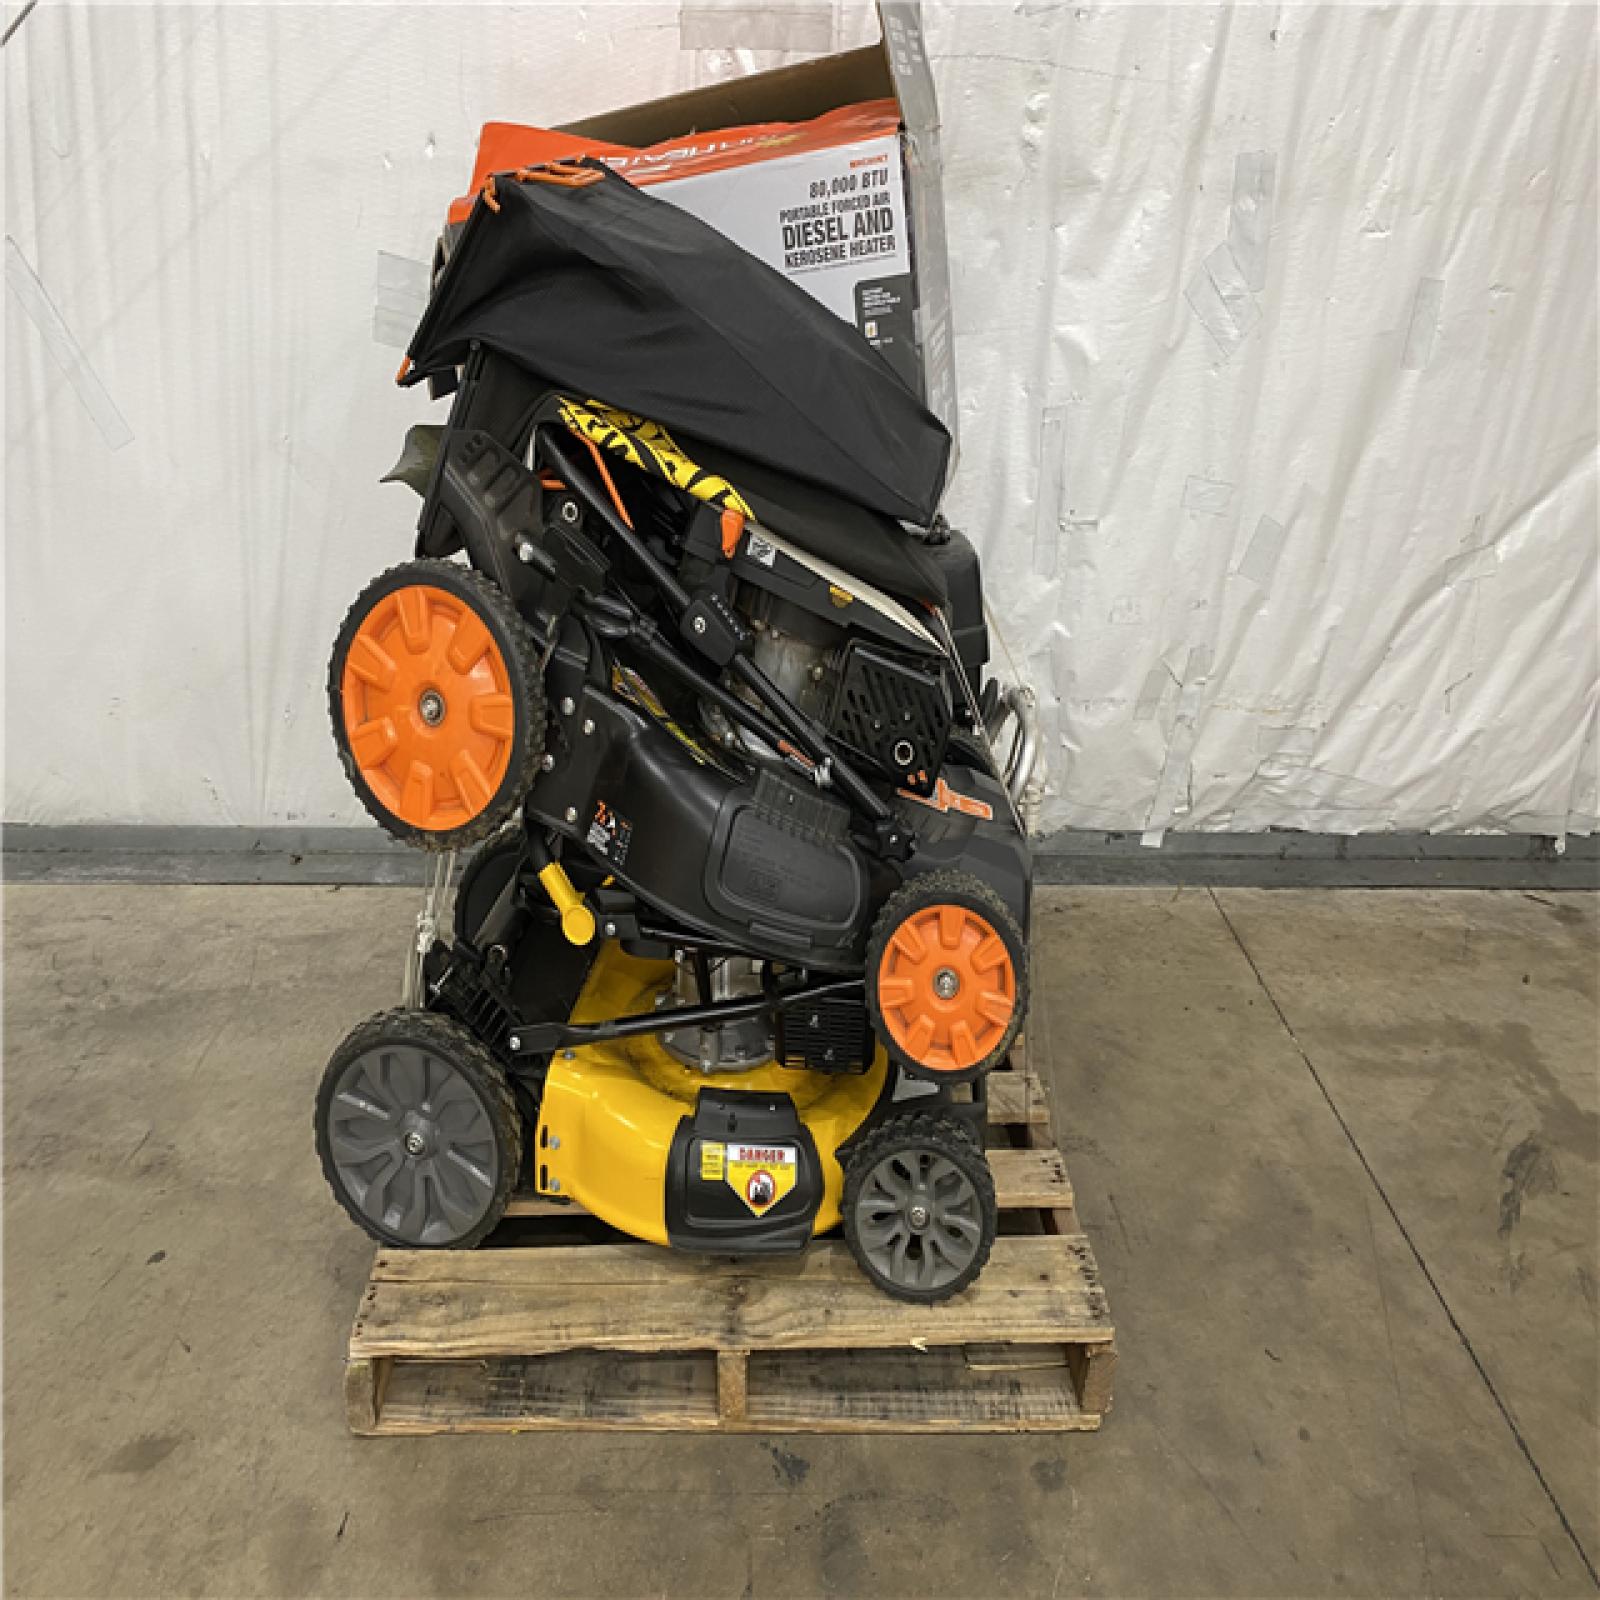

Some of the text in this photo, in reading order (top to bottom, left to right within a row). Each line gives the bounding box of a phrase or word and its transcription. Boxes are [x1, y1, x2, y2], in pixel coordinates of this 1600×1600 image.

[810, 168, 888, 199] 80,000 BTU
[779, 203, 829, 223] PORTABLE
[782, 207, 893, 251] DIESEL AND
[784, 236, 896, 268] KEROSENE HEATER
[739, 1147, 785, 1162] DANGER
